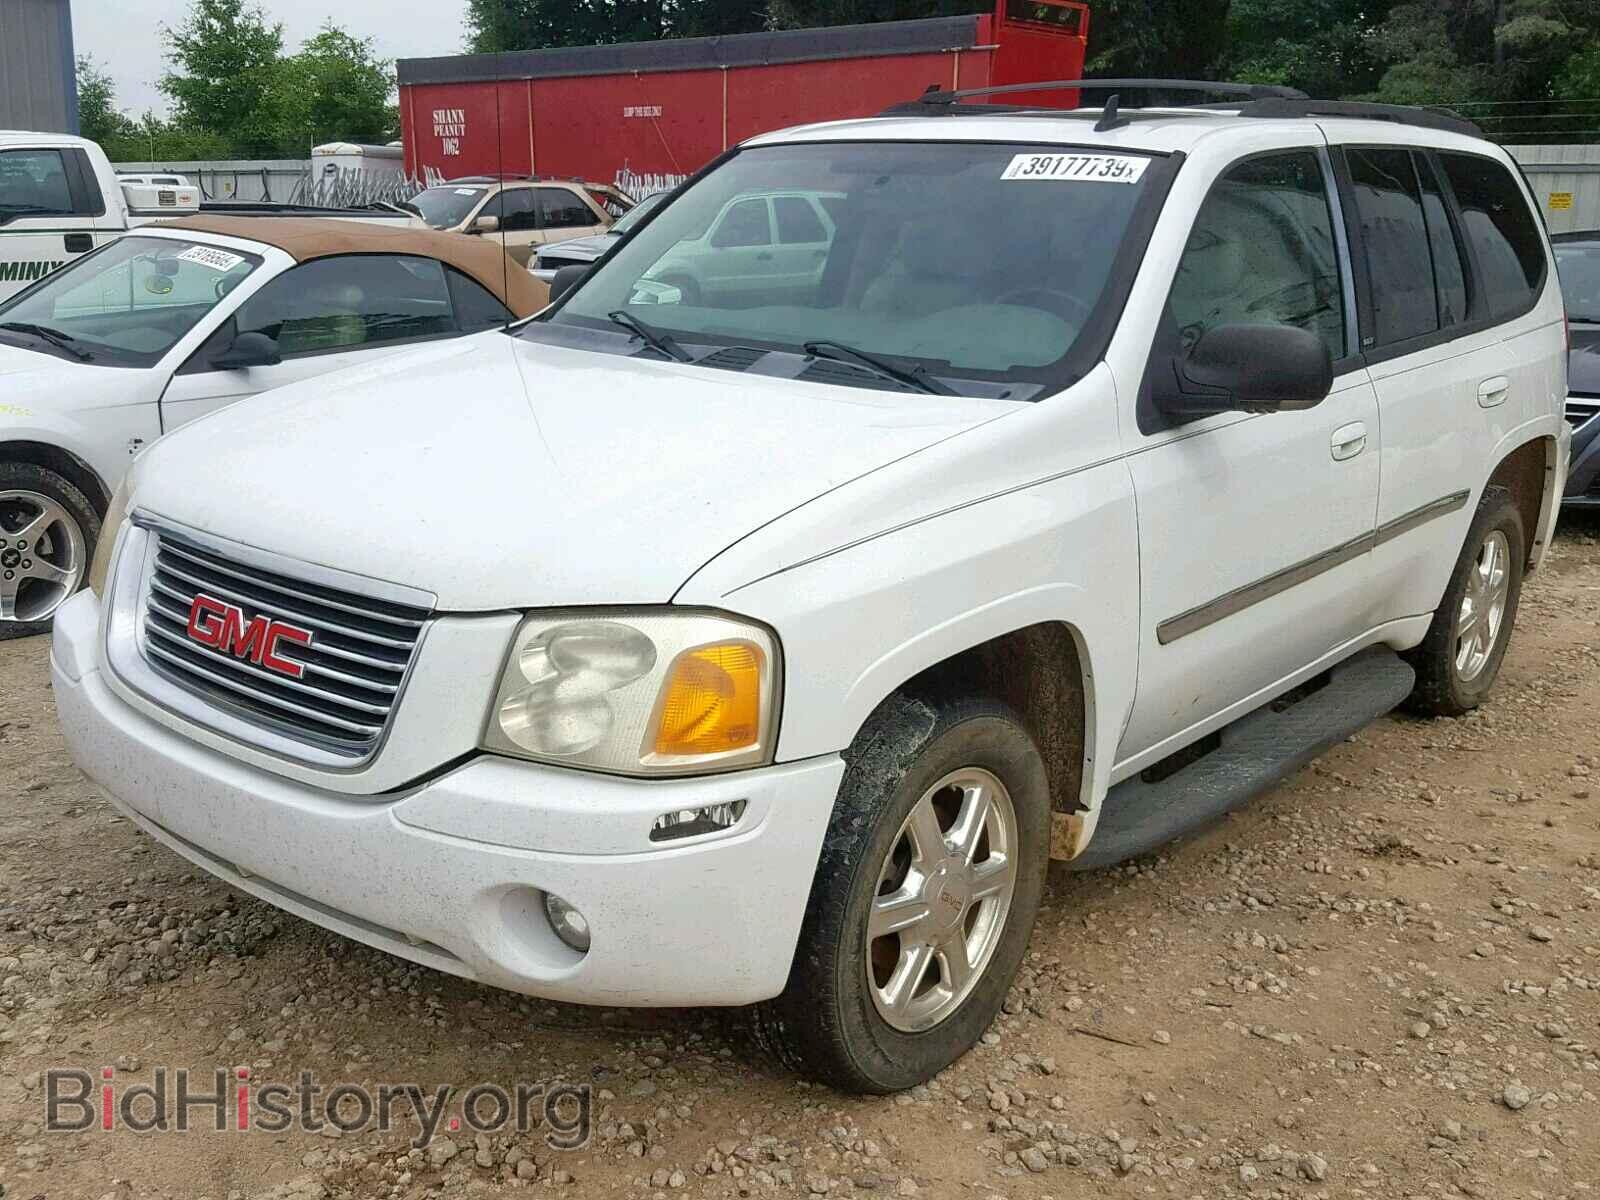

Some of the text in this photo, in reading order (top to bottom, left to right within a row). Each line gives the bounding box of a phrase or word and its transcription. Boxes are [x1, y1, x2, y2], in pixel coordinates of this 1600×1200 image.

[433, 109, 465, 124] SHANN
[433, 124, 466, 137] PEANUT
[442, 137, 460, 156] 1062
[187, 592, 314, 680] GMC
